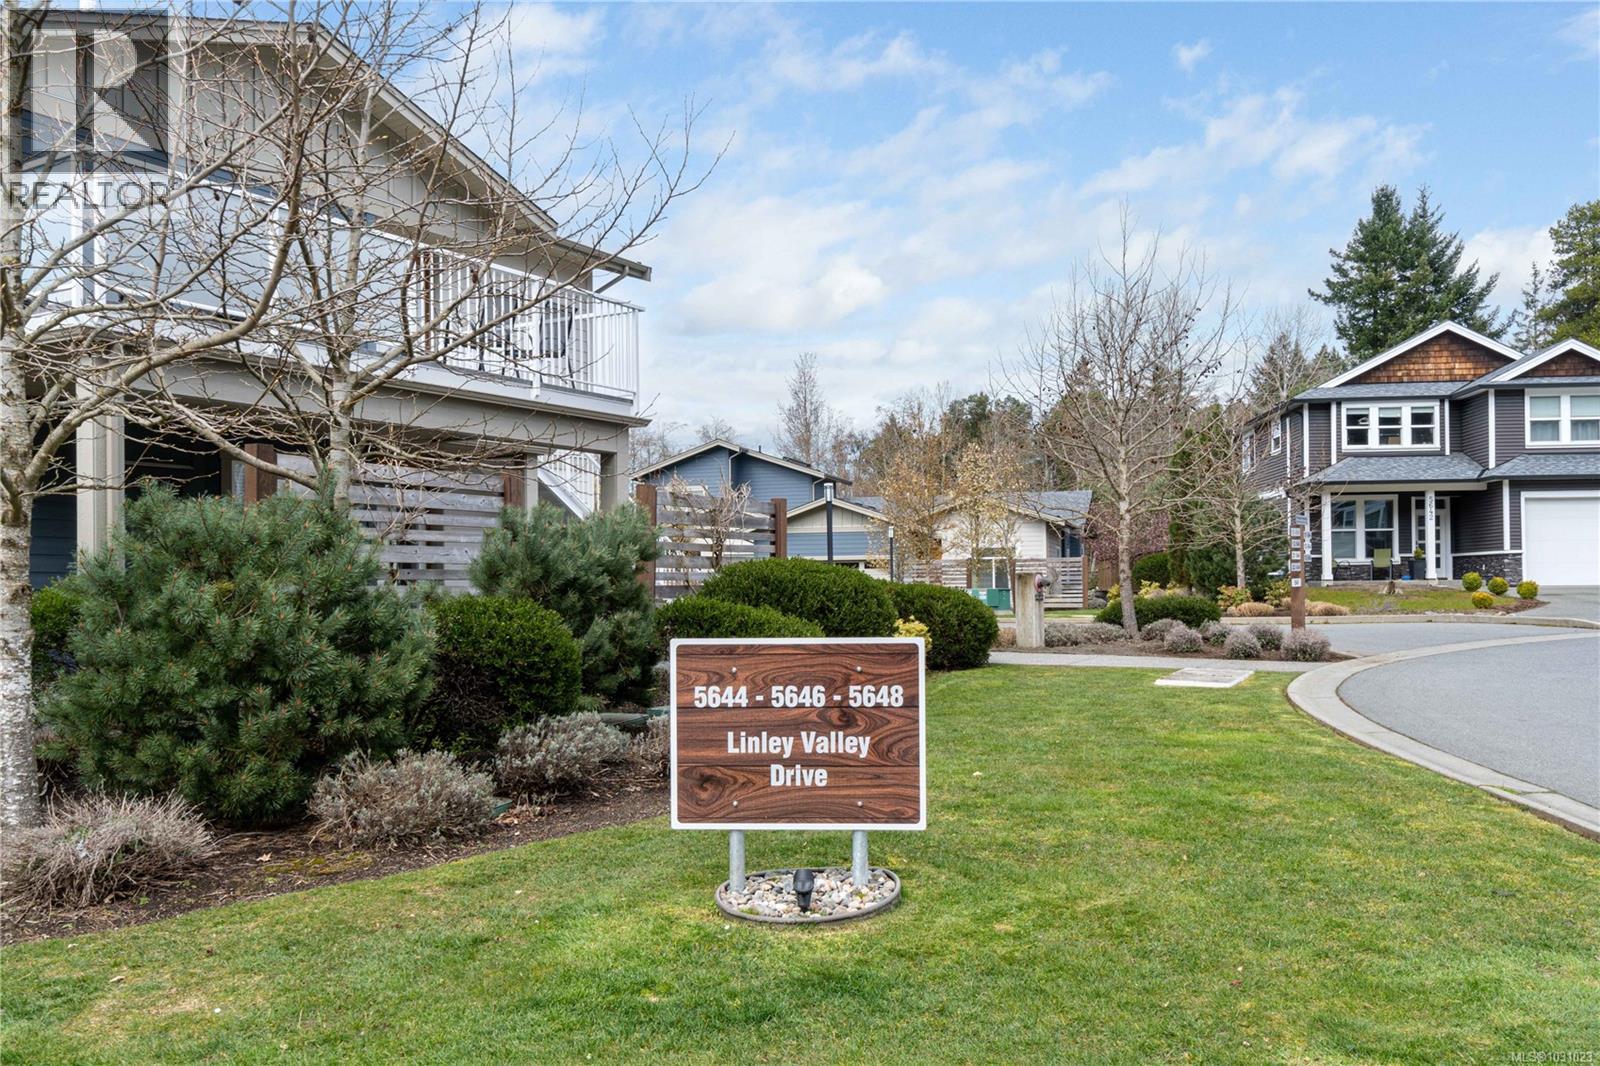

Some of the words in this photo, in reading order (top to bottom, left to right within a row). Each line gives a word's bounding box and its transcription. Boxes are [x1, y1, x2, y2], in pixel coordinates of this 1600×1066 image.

[694, 686, 748, 708] 5644
[771, 685, 825, 707] 5646
[849, 685, 904, 707] 5648
[727, 731, 794, 758] Linley
[800, 731, 870, 758] Valley
[770, 764, 828, 787] Drive
